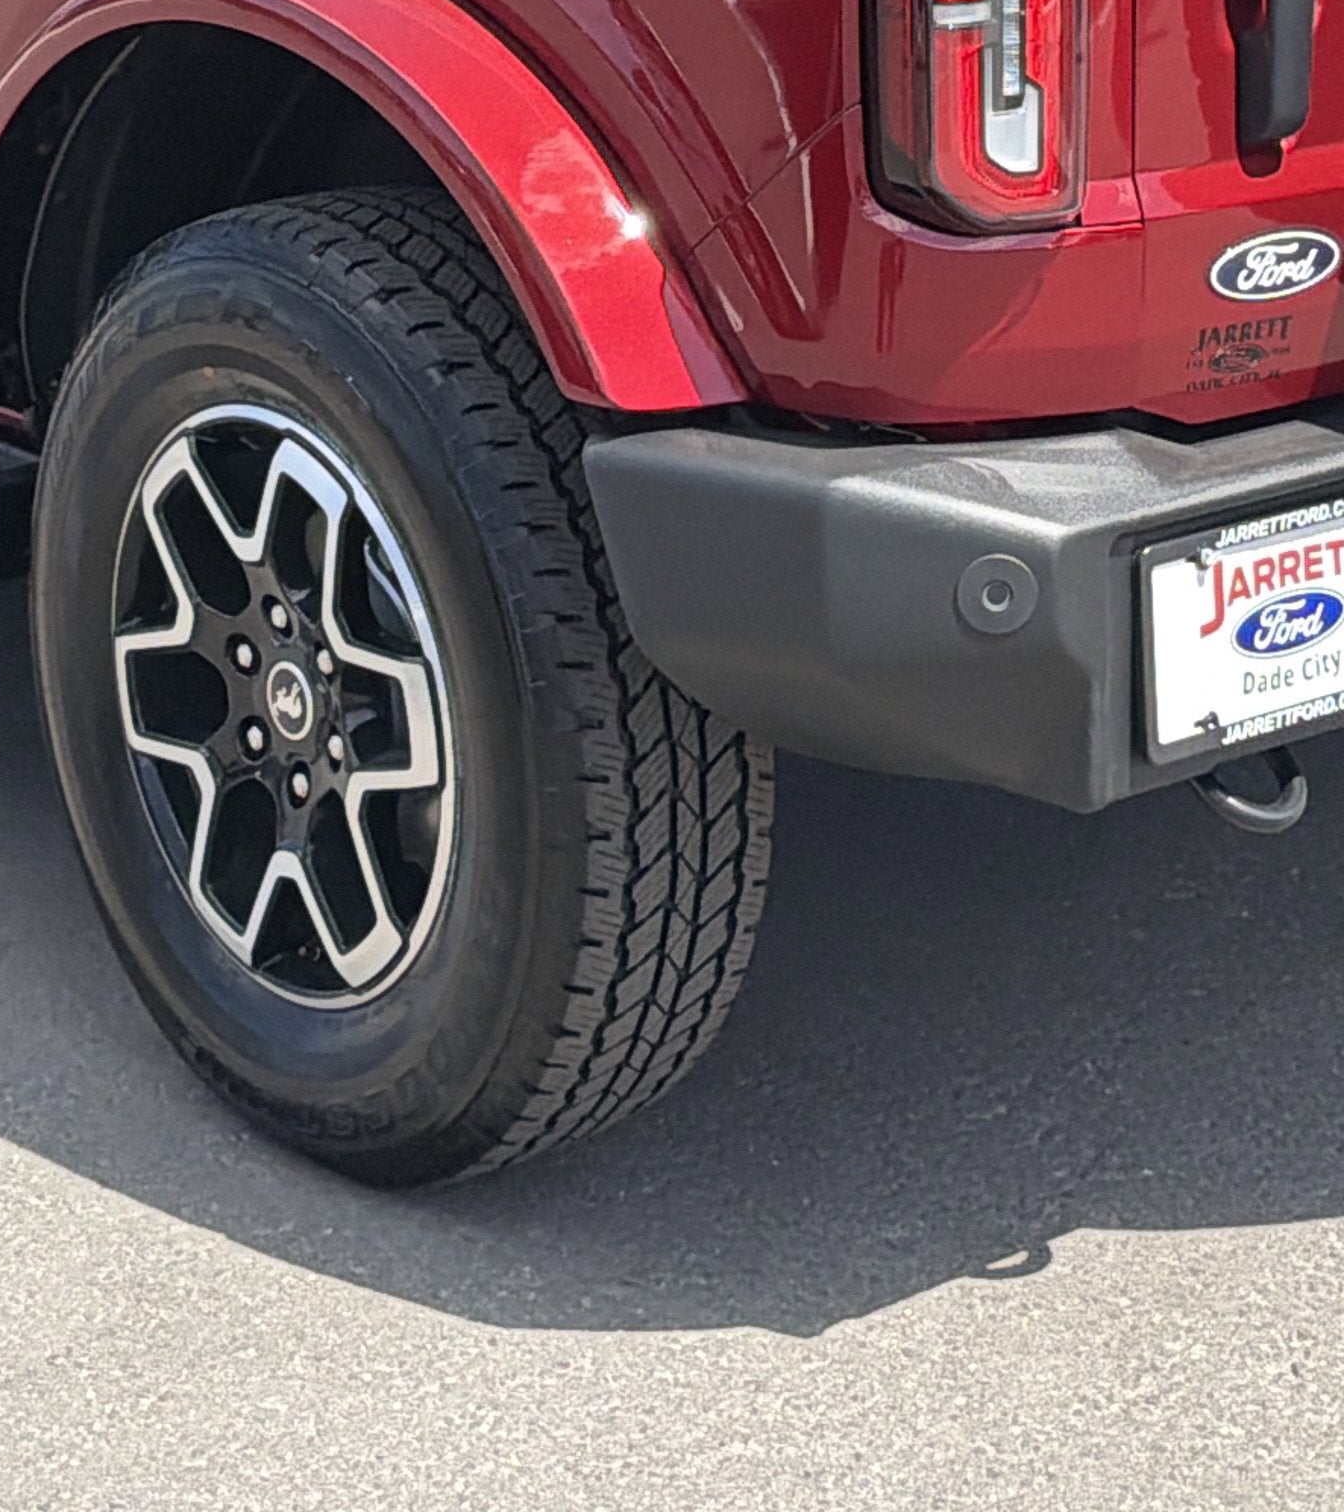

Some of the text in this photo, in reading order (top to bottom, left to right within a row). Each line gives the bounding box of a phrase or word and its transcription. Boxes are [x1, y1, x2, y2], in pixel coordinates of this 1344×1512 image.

[1236, 242, 1319, 291] Ford
[1197, 315, 1293, 352] JARRETT
[1253, 599, 1325, 650] Ford
[1242, 648, 1342, 696] Dade City
